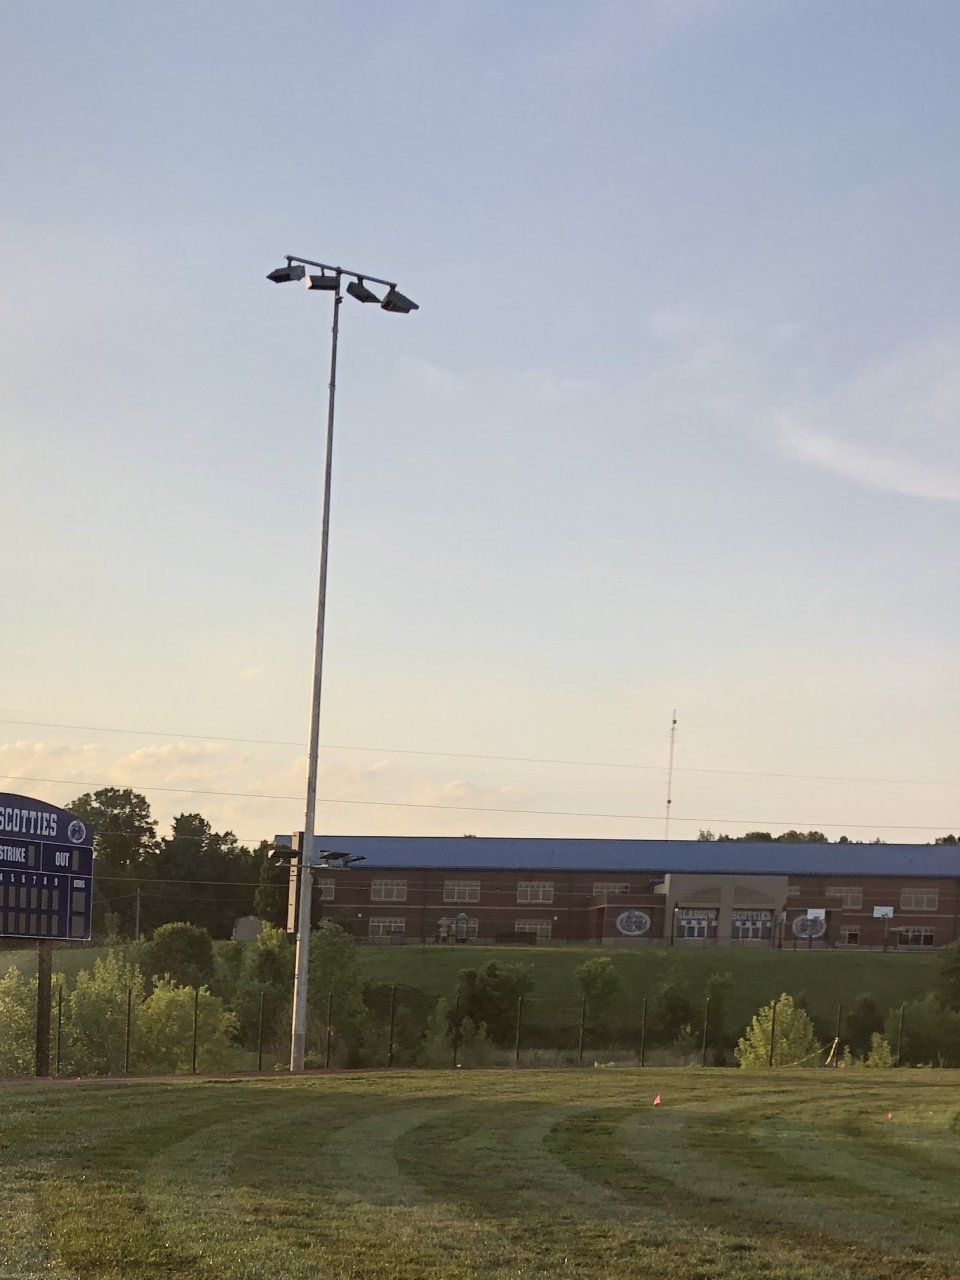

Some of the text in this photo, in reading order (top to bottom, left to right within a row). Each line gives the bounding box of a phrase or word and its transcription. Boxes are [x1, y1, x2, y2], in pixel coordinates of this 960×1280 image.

[55, 852, 69, 867] OUT
[0, 872, 4, 882] 4
[10, 873, 15, 882] 5
[21, 874, 26, 883] 6
[33, 875, 37, 885] 7
[43, 876, 48, 885] 8
[54, 877, 59, 886] 9
